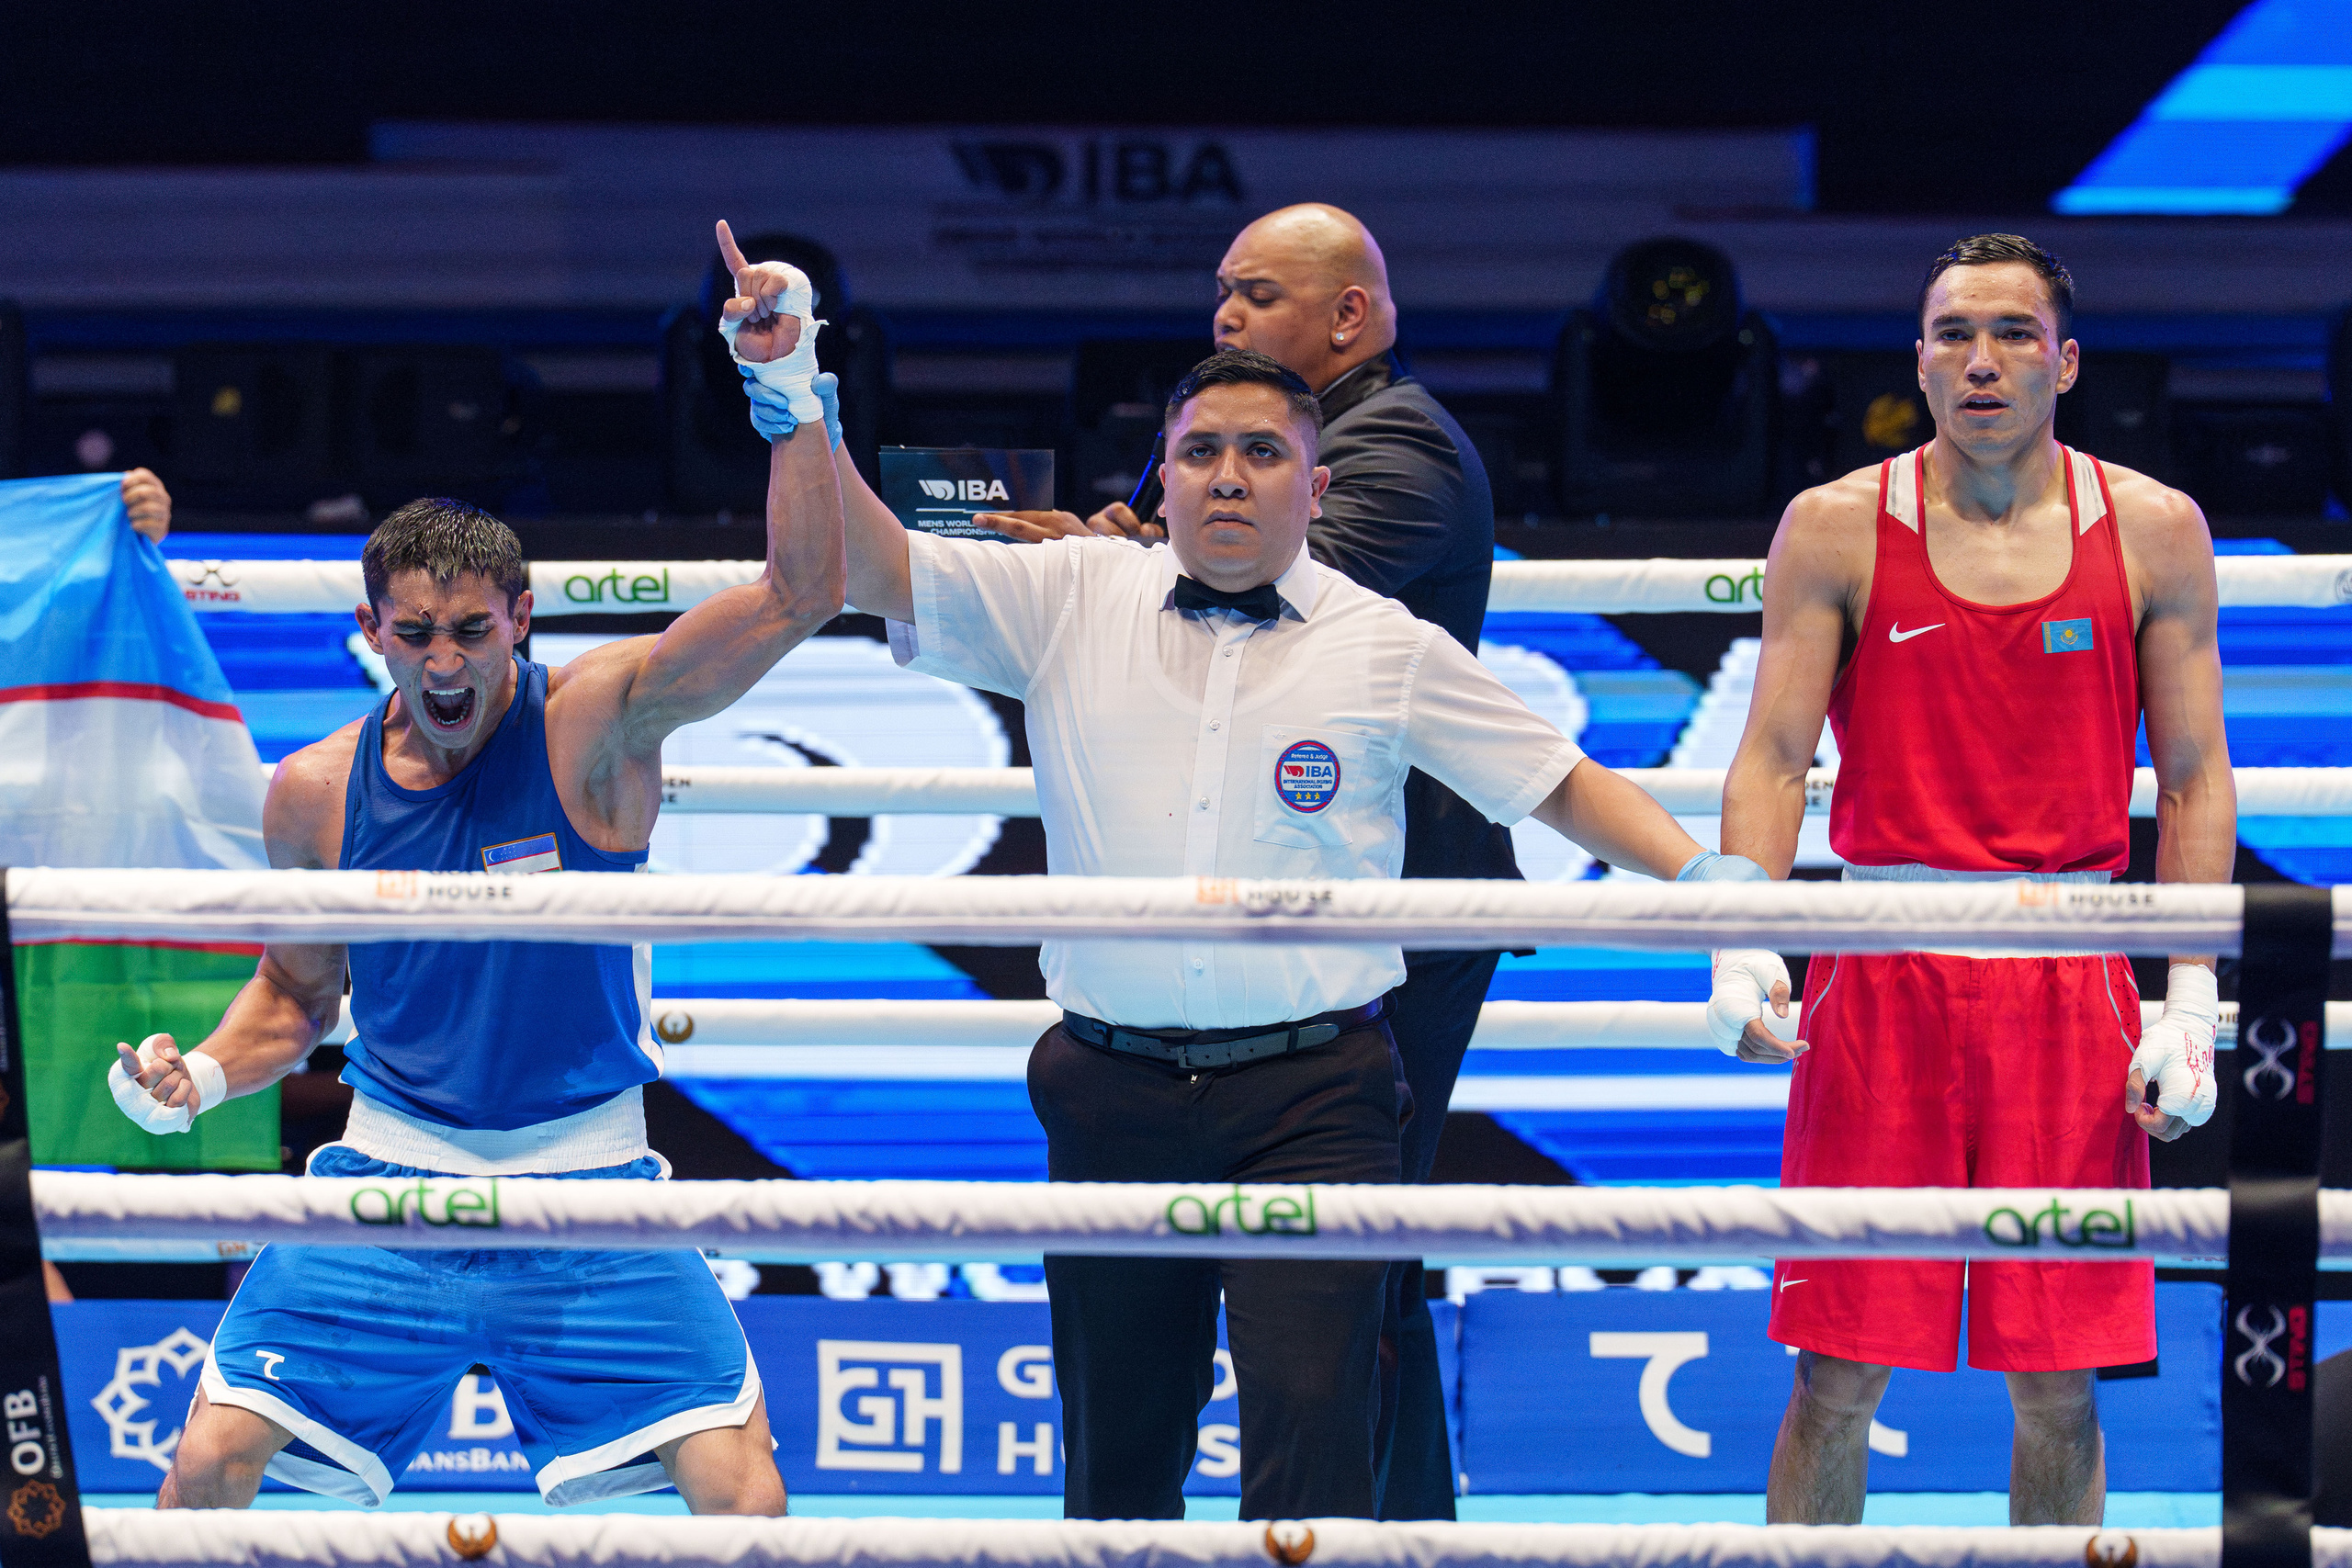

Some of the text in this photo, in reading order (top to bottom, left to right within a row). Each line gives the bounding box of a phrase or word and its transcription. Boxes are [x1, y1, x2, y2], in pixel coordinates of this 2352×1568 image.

[957, 479, 1010, 501] IBA
[564, 568, 669, 603] artel
[1705, 567, 1764, 603] art
[1306, 765, 1333, 778] IBA
[427, 886, 513, 899] HOUSE
[350, 1177, 501, 1227] artel
[1167, 1183, 1317, 1235] artel
[1984, 1197, 2136, 1248] artel
[3, 1388, 46, 1476] OFB
